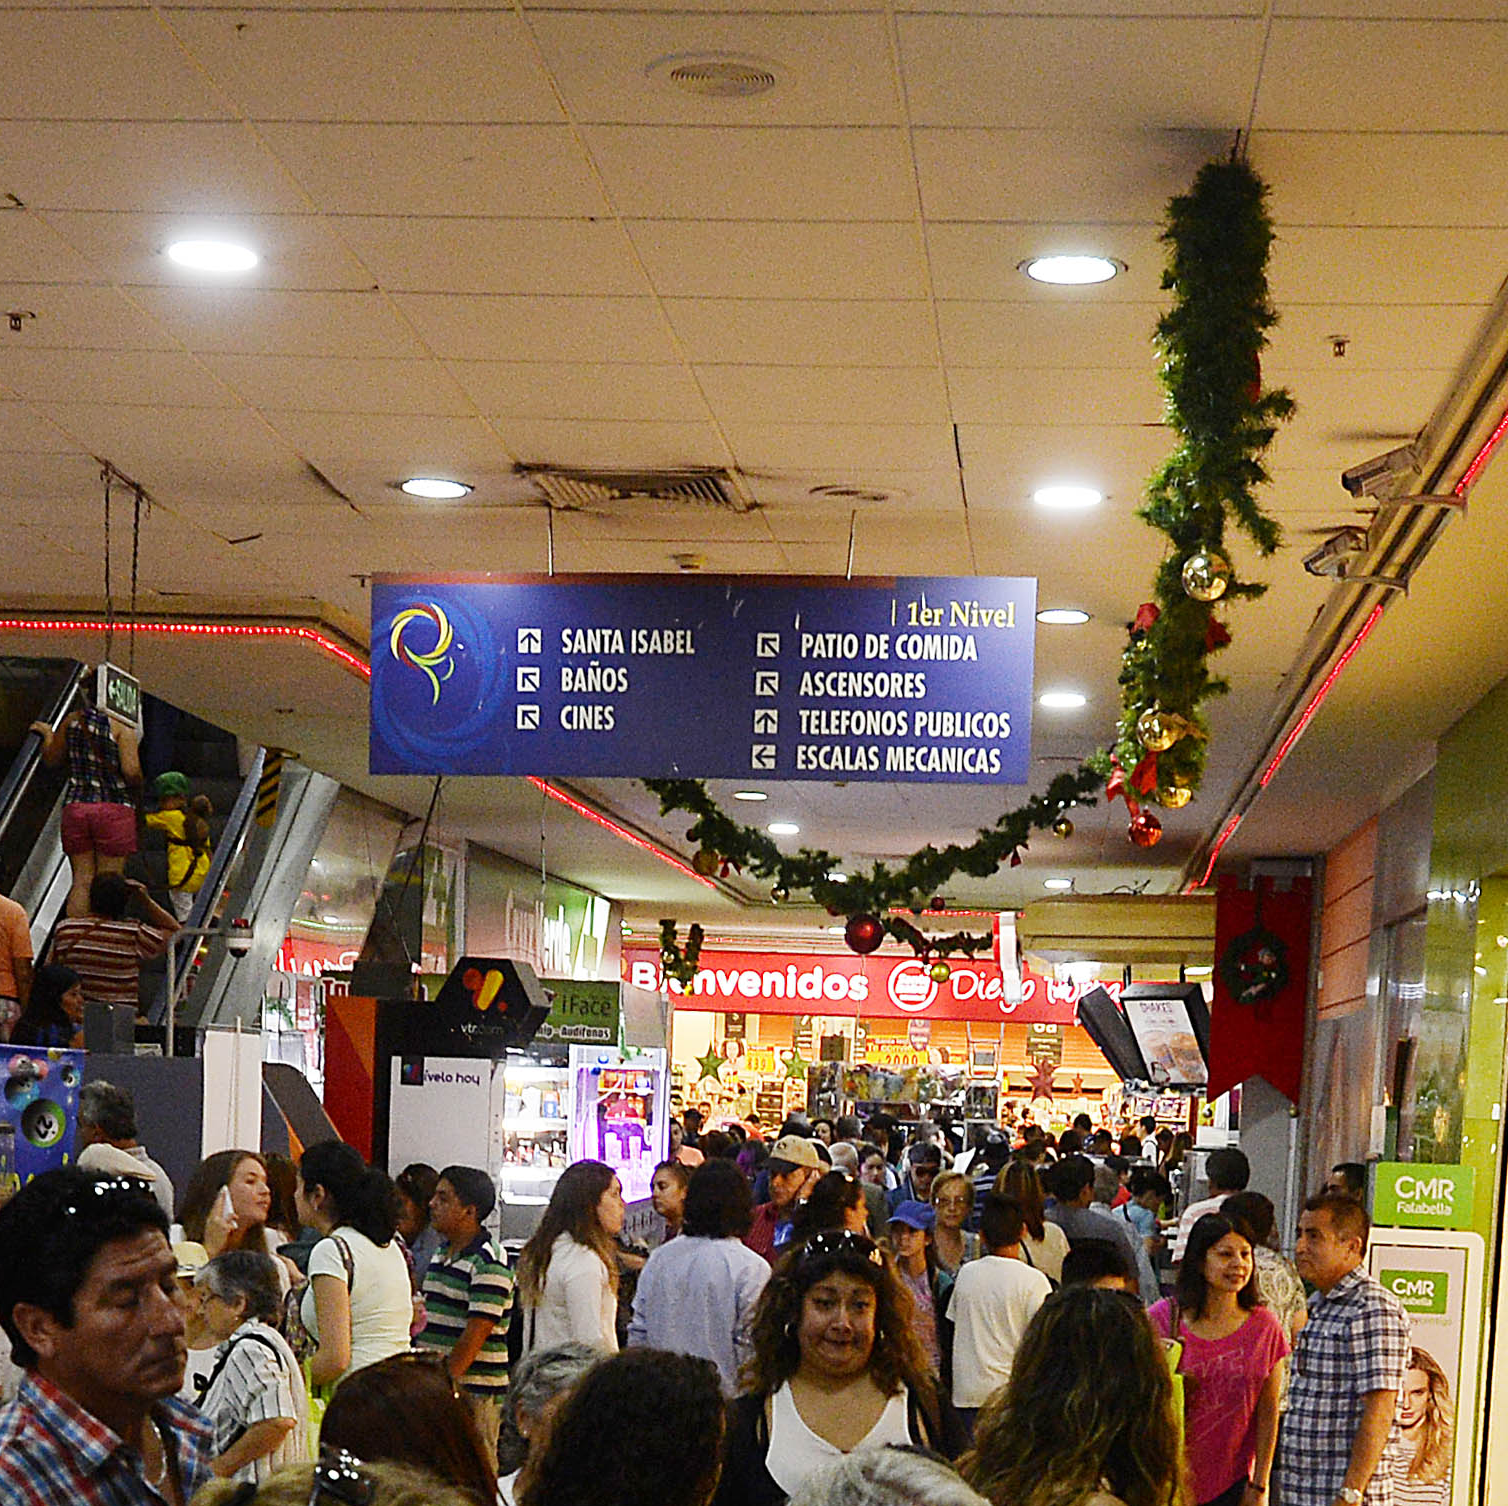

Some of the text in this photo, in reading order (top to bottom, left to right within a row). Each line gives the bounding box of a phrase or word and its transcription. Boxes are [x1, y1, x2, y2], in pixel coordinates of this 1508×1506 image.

[907, 600, 1016, 628] 1er Nivel
[561, 628, 695, 655] SANTA ISABEL
[800, 633, 978, 661] PATIO DE COMIDA
[560, 660, 629, 693] BAÑOS
[799, 671, 927, 699] ASCENSORES
[559, 704, 616, 731] CINES
[798, 709, 1011, 739] TELEFONOS PUBLICOS
[796, 745, 1002, 774] ESCALAS MECANICAS
[423, 1069, 453, 1084] ívelo
[1394, 1175, 1456, 1202] CMR
[1396, 1201, 1453, 1216] Falabella
[1392, 1277, 1435, 1297] CMR
